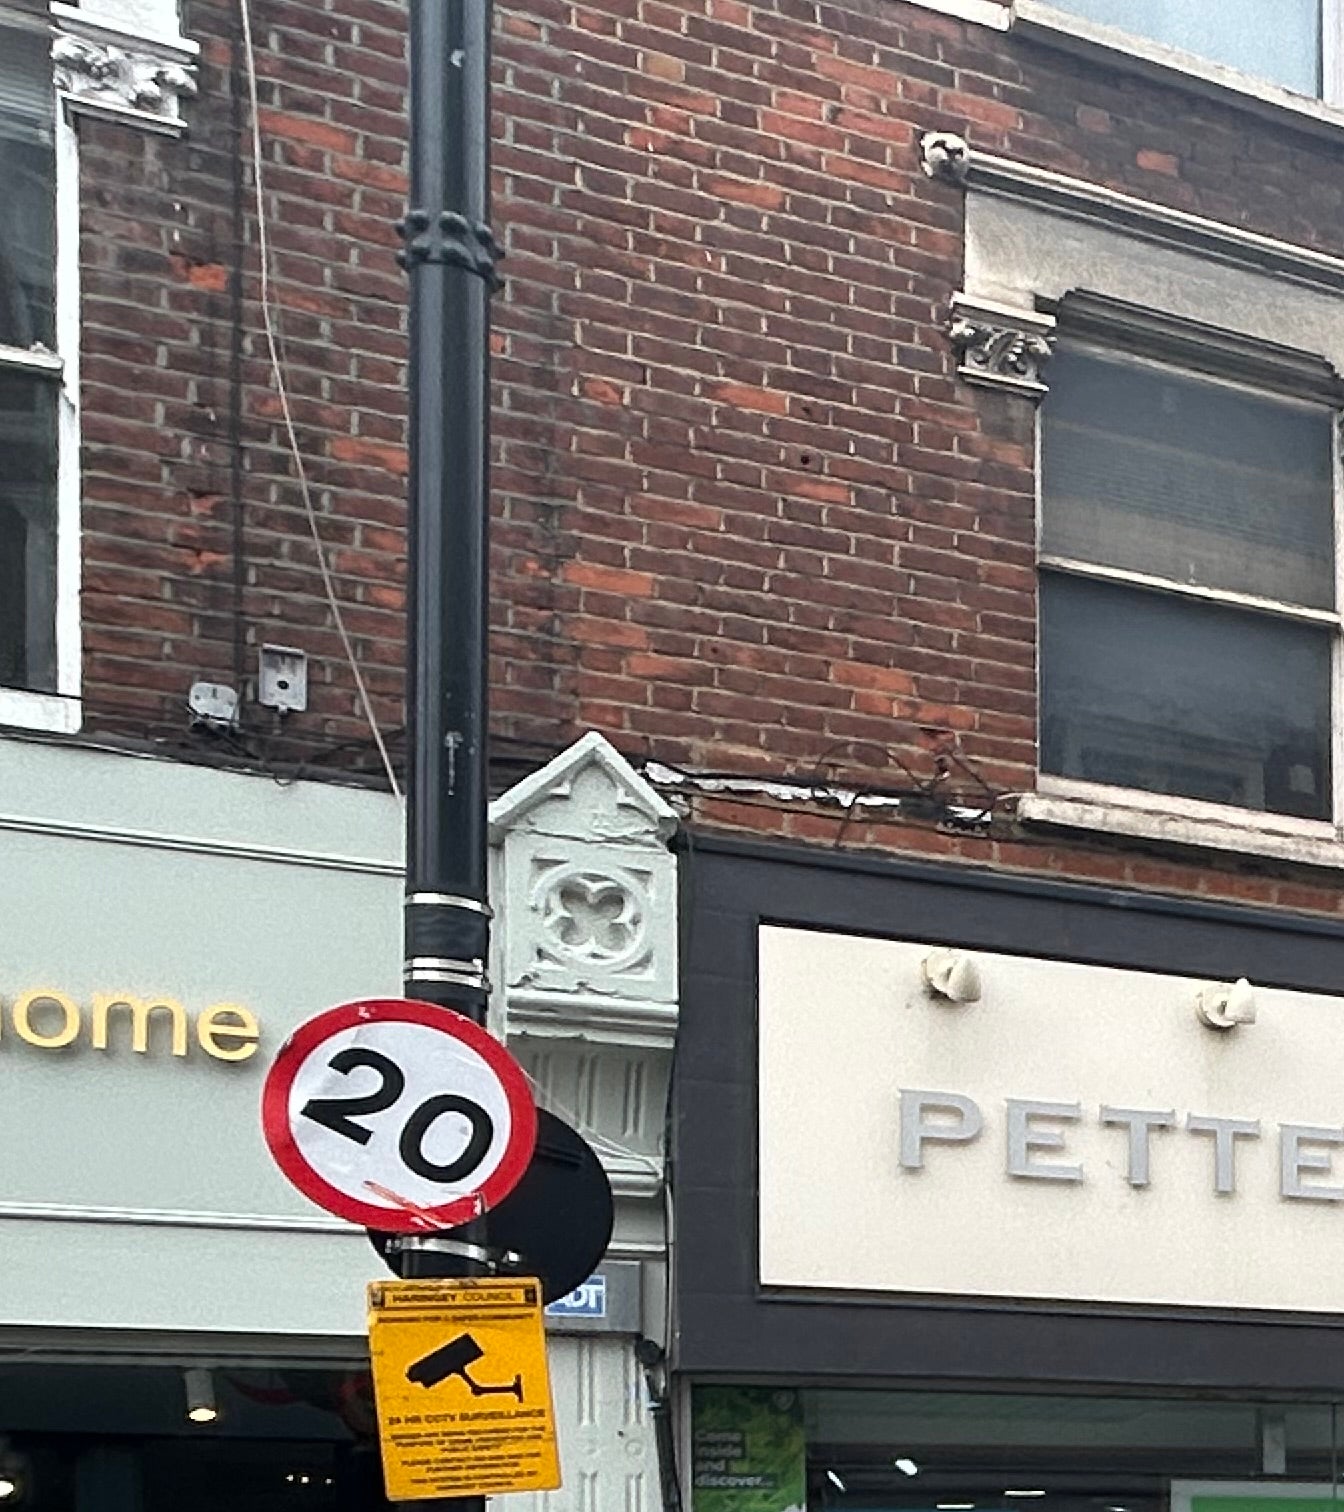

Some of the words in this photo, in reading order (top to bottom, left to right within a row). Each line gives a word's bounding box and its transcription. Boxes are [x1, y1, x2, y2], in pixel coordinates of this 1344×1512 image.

[0, 985, 260, 1062] ome
[301, 1047, 494, 1184] 20
[462, 1292, 514, 1302] COUNCIL
[424, 1413, 456, 1424] CCTV
[458, 1409, 546, 1422] SURVEILLANCE
